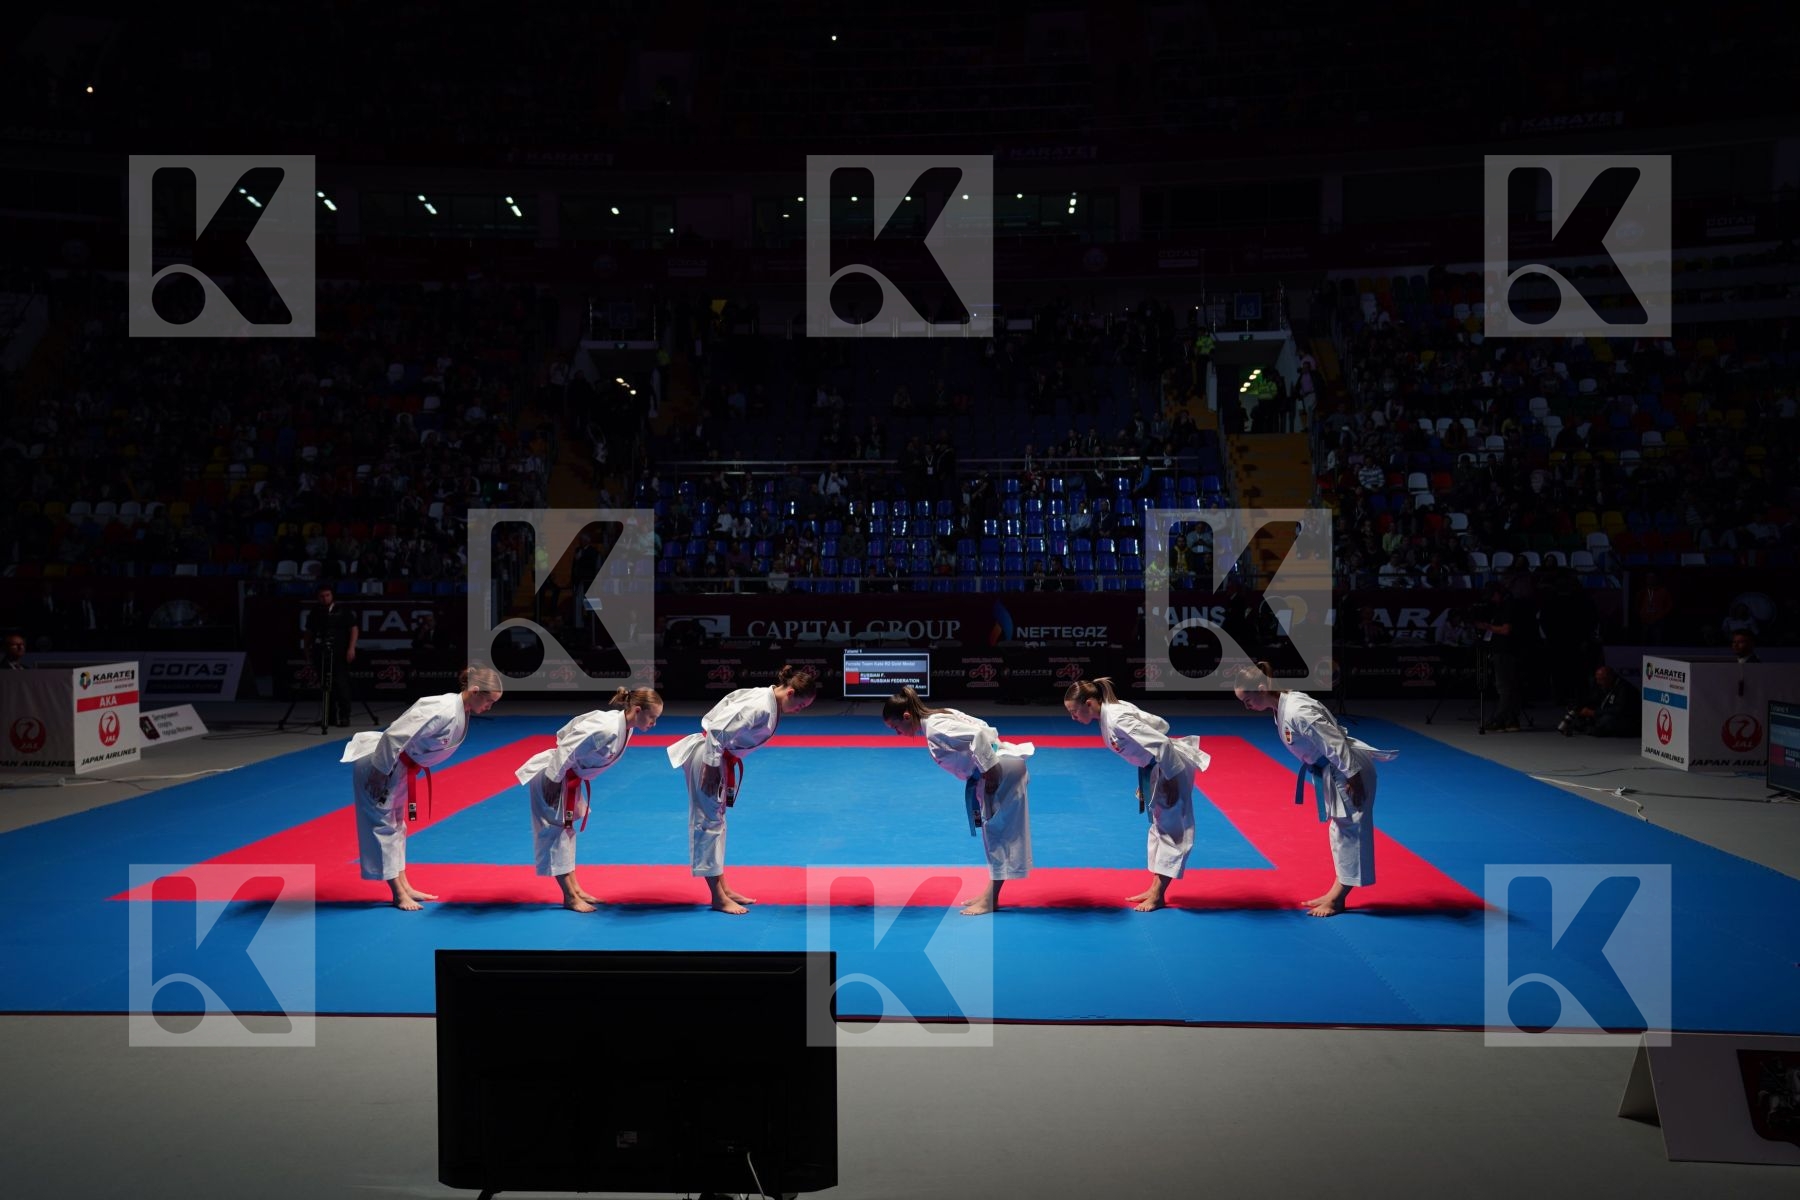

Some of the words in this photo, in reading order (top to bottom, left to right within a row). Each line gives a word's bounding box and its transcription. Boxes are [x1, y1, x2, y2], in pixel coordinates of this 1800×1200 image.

[747, 619, 853, 641] CAPITAL
[866, 619, 961, 641] GROUP
[1016, 625, 1109, 639] NEFTEGAZ
[150, 663, 228, 676] СОГАЗ
[99, 696, 118, 708] AKA
[81, 755, 104, 766] JAPAN
[105, 747, 137, 760] AIRLINES
[1645, 746, 1660, 757] JAPAN
[1661, 751, 1684, 764] AIRLINES
[1689, 759, 1730, 767] JAPAN
[1732, 759, 1768, 767] AIRLI
